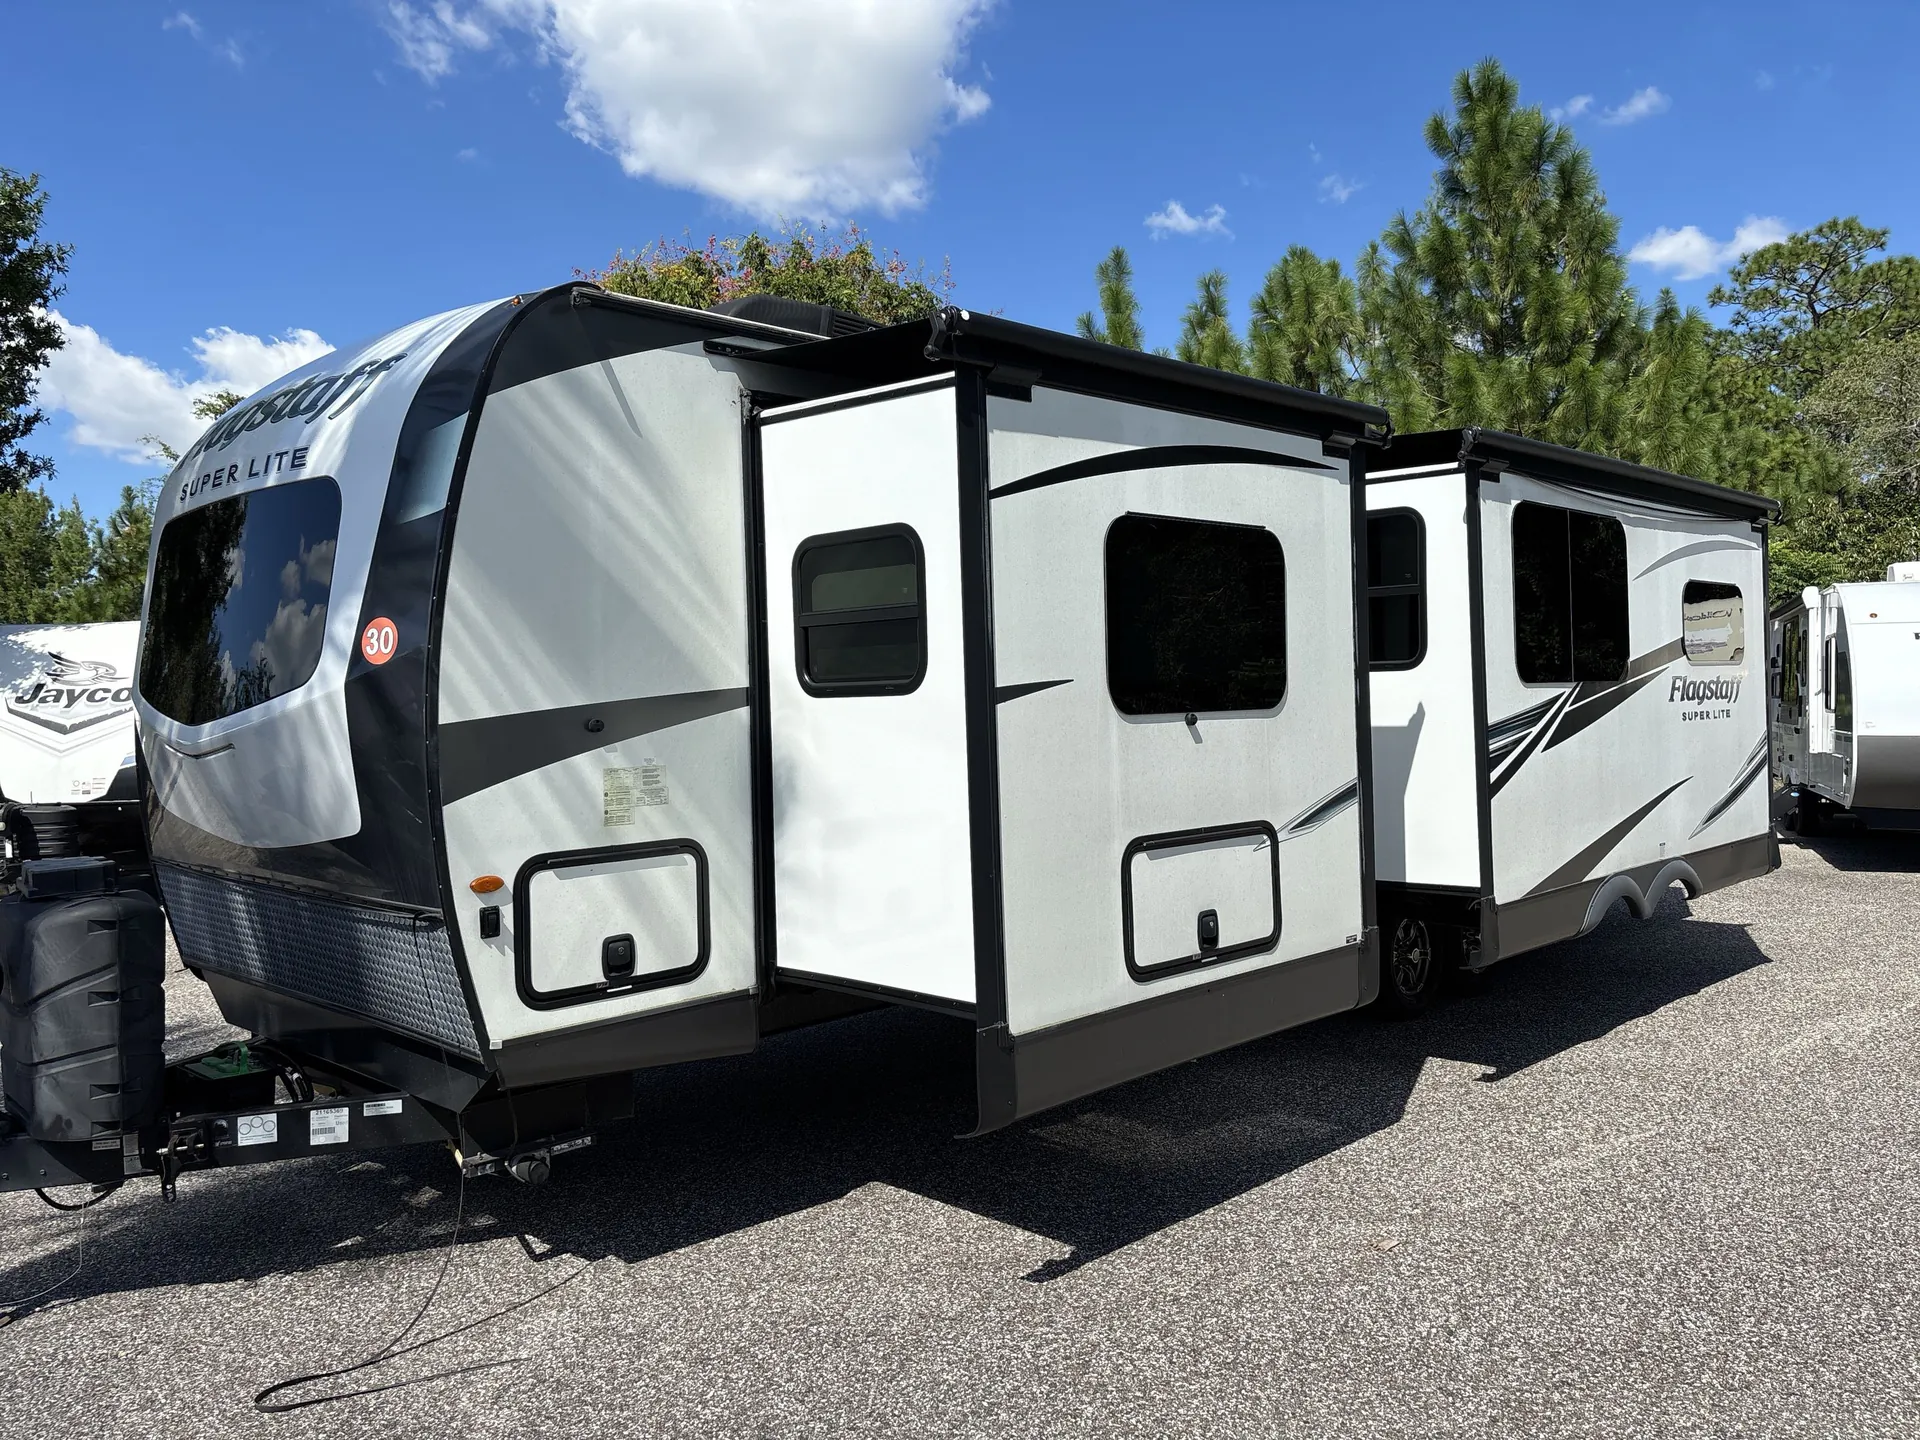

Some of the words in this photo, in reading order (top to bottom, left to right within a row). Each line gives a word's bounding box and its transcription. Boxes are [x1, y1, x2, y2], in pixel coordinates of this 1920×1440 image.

[180, 464, 237, 502] SUPER
[249, 446, 309, 478] LITE
[365, 626, 394, 656] 30
[14, 683, 133, 708] Jayco
[1668, 674, 1743, 705] Flagstaff
[1682, 711, 1711, 722] SUPER
[1713, 709, 1731, 720] LITE
